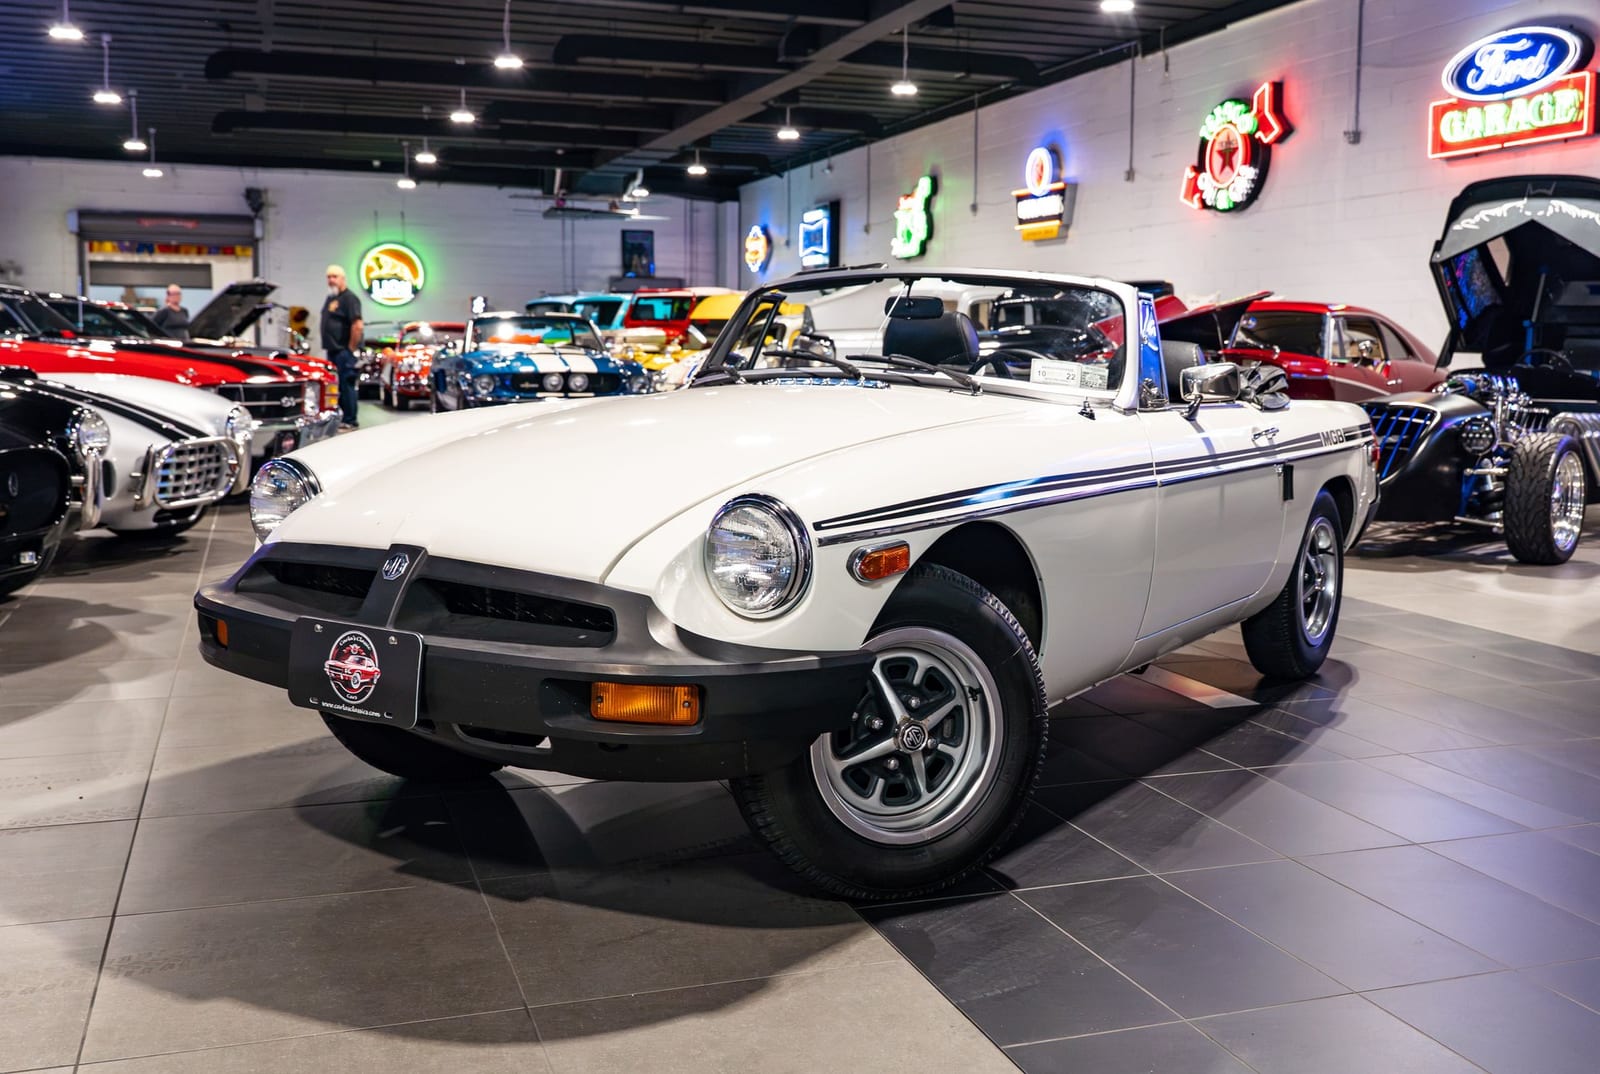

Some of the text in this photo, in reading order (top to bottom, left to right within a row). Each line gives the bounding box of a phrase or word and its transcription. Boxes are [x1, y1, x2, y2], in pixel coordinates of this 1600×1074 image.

[1466, 38, 1555, 91] Ford
[1440, 88, 1583, 143] GARAGE
[1066, 373, 1076, 381] 22
[1321, 428, 1345, 447] MGB
[906, 729, 922, 745] MG
